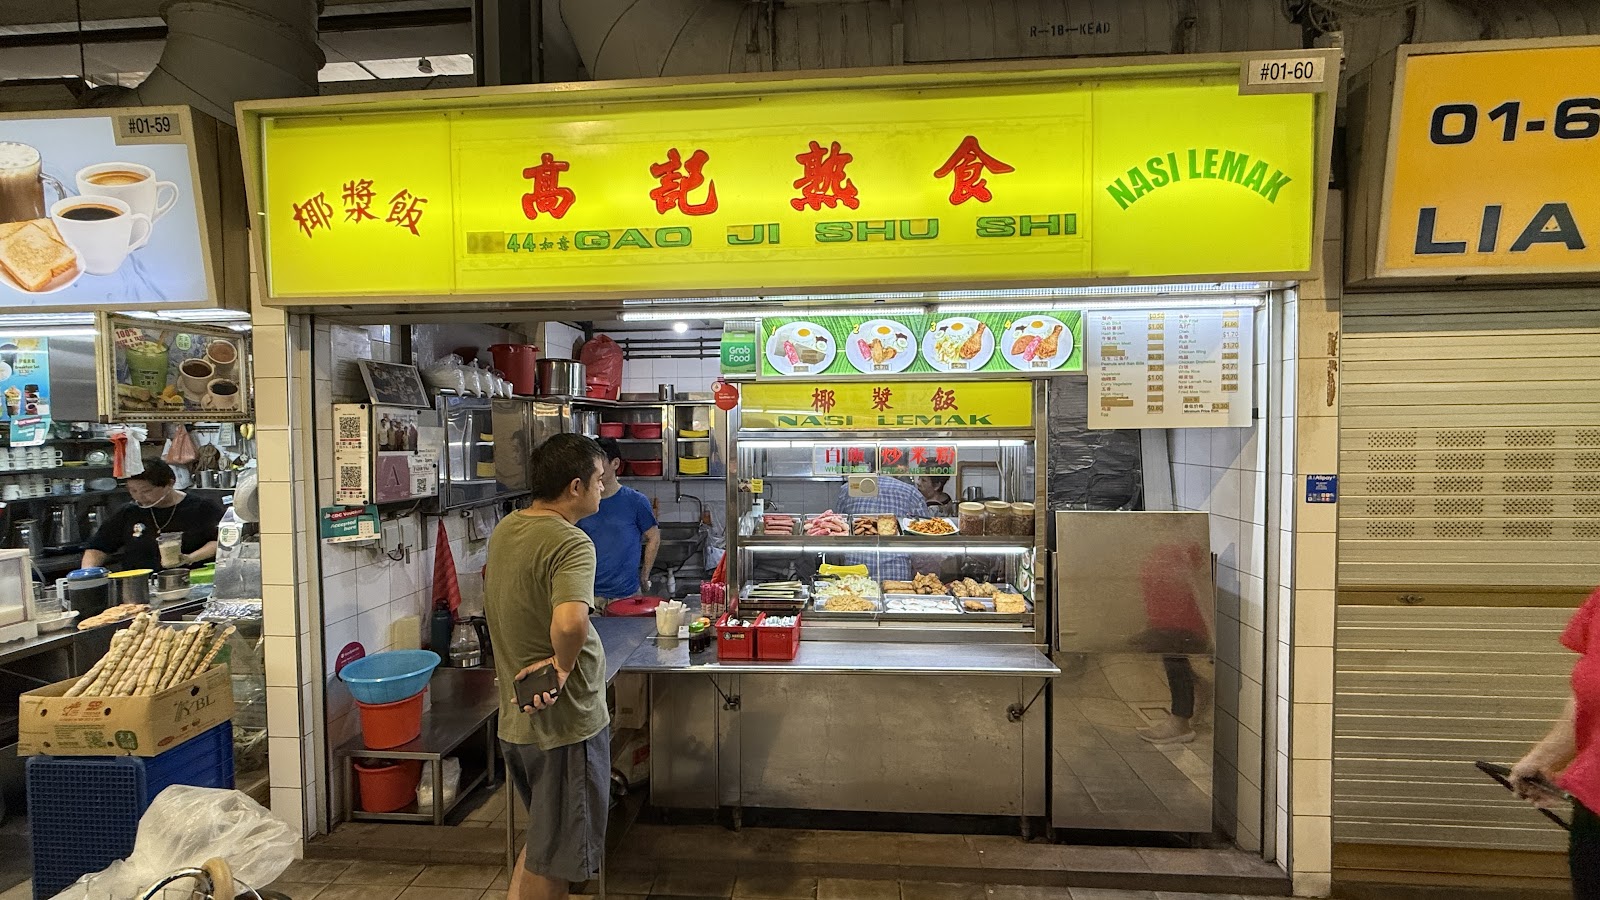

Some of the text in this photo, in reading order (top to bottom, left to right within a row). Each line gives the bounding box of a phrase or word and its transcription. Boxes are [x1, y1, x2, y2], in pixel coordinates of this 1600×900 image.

[1260, 61, 1314, 81] #01-60
[128, 116, 171, 134] #01-59
[1105, 148, 1293, 211] NASI LEMAK
[574, 213, 1077, 250] GAO JI SHU SHI
[1415, 203, 1587, 255] LIA
[852, 323, 861, 334] 2
[929, 322, 938, 332] 3
[1004, 319, 1012, 330] 4
[116, 328, 138, 340] 100%
[771, 326, 777, 336] 1
[728, 345, 751, 354] Grab
[728, 354, 751, 362] Food
[777, 414, 993, 427] NASI LEMAK
[881, 446, 956, 465] 炒米粉
[385, 463, 402, 488] A
[929, 466, 956, 474] HOON
[330, 519, 357, 529] Accepted
